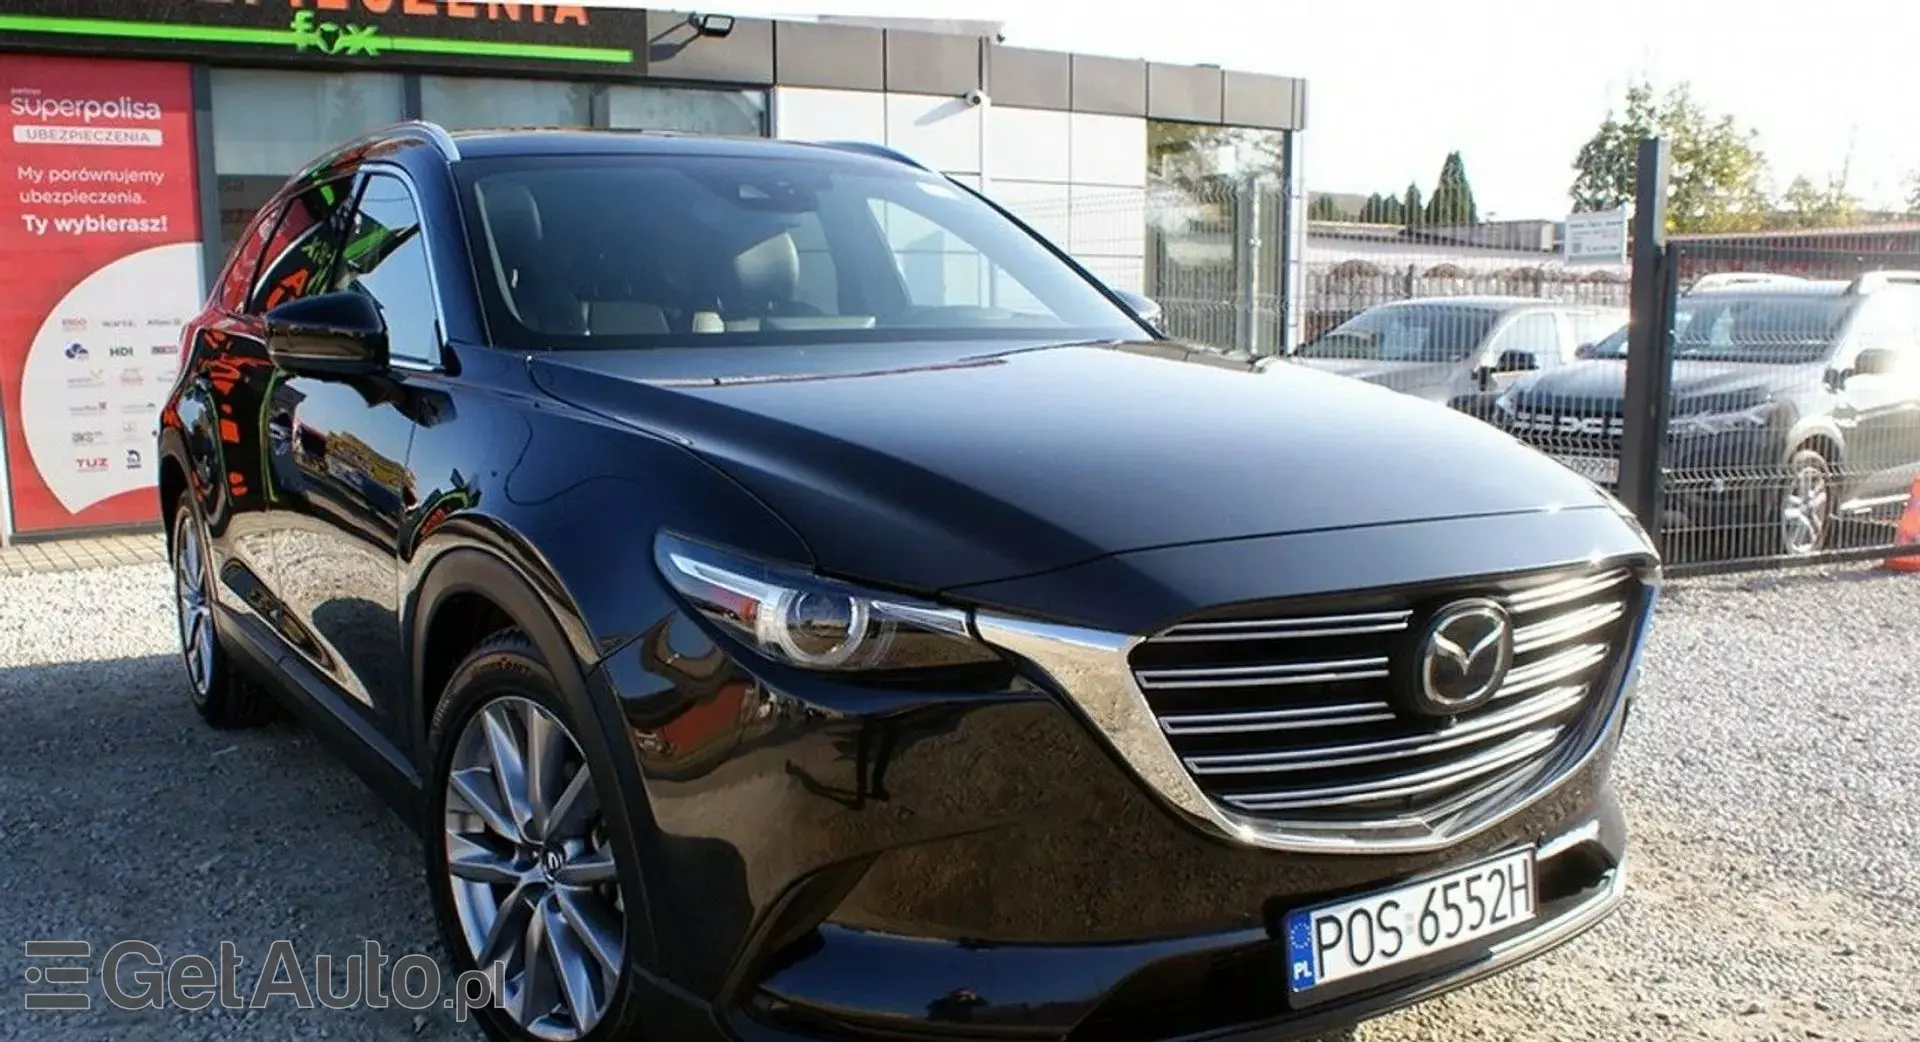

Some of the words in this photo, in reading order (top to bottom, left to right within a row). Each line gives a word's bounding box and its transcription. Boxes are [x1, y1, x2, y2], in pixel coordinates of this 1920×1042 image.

[290, 10, 380, 56] fox
[10, 96, 161, 123] superpolisa
[26, 128, 151, 143] UBEZPIECZENIA
[17, 166, 44, 184] My
[48, 167, 165, 186] porównujemy
[19, 188, 147, 206] ubezpieczenia.
[21, 214, 49, 235] Ty
[53, 213, 169, 235] wybierasz!
[1314, 899, 1403, 979] POS
[1418, 857, 1530, 946] 6552H
[1293, 961, 1313, 980] PL
